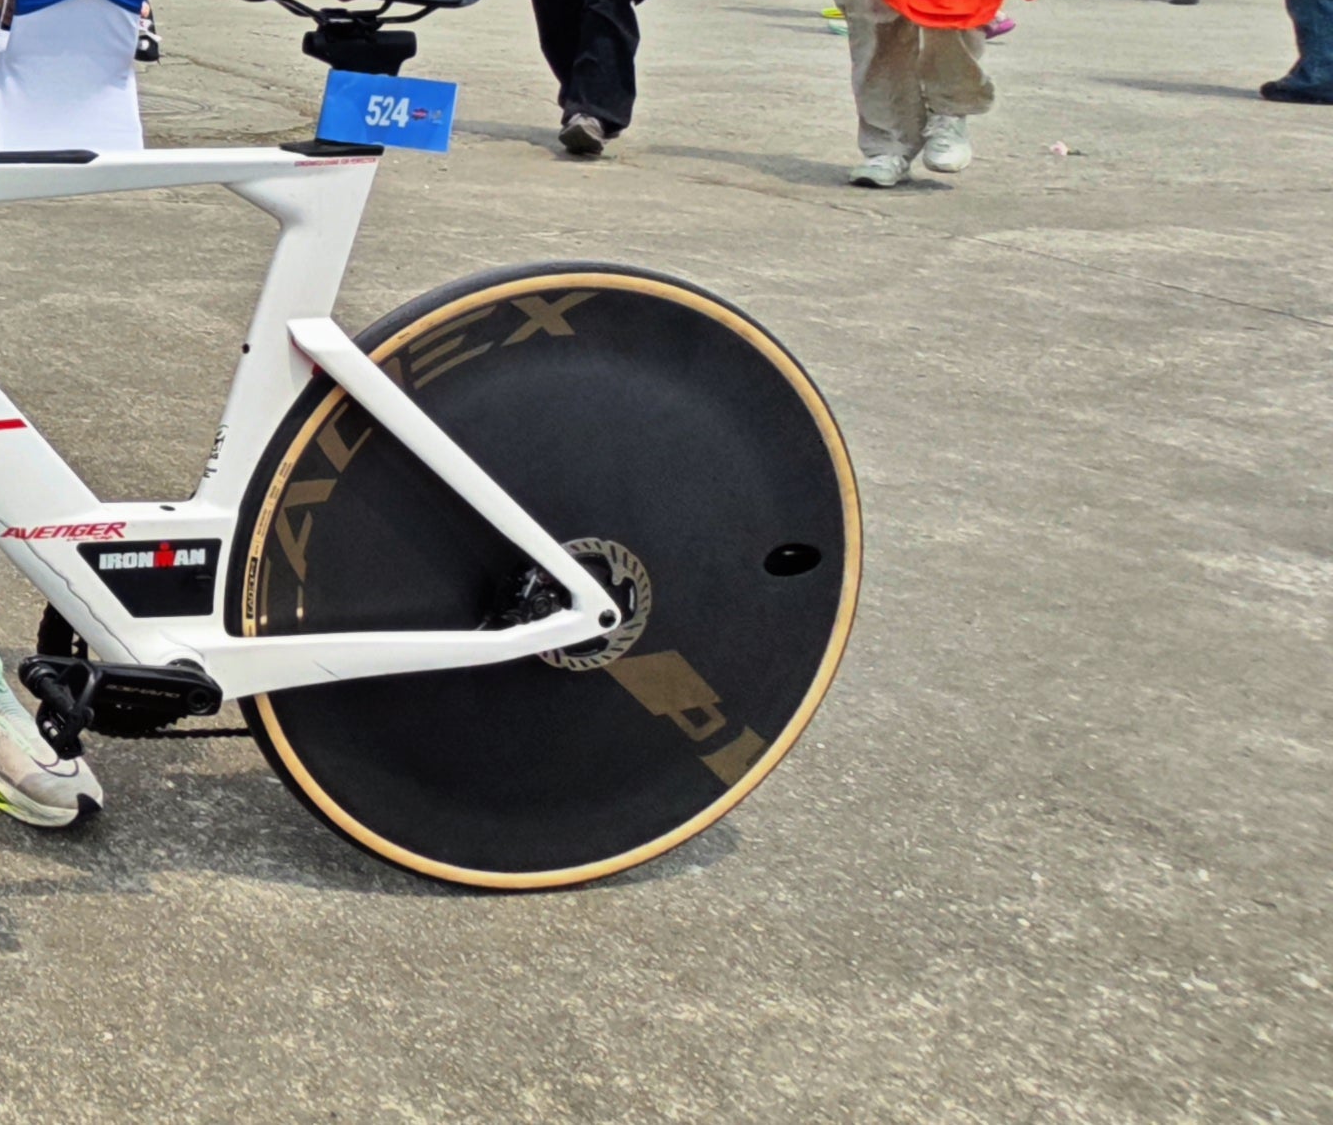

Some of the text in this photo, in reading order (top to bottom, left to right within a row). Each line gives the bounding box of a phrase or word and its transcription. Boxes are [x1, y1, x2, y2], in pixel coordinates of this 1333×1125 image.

[365, 94, 411, 128] 524
[265, 291, 600, 615] ADEX
[0, 522, 127, 540] AVENGER
[99, 542, 206, 570] IRONMAN
